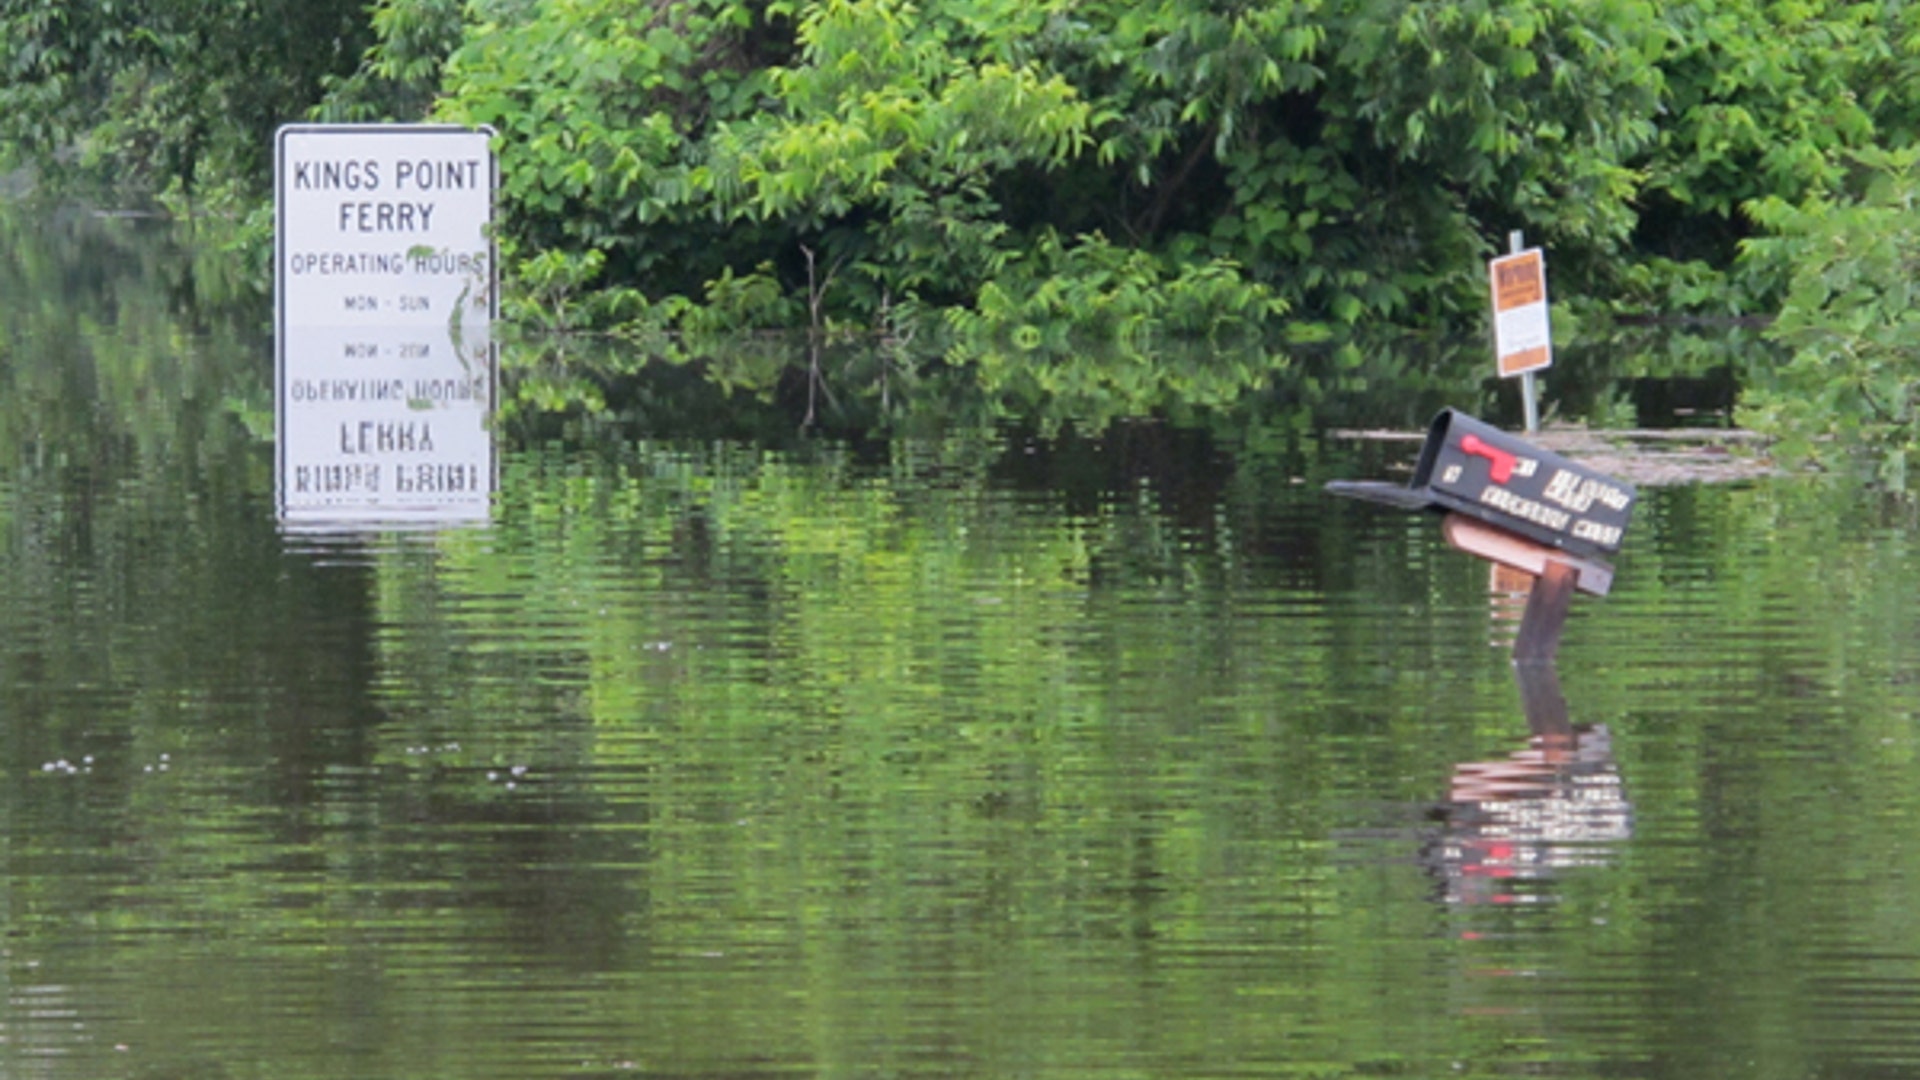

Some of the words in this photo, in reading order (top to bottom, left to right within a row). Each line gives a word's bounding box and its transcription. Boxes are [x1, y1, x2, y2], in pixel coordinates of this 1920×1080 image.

[294, 160, 380, 190] KINGS
[396, 160, 479, 190] POINT
[340, 203, 433, 232] FERRY
[291, 253, 404, 275] OPERATING
[344, 297, 378, 311] MON
[400, 297, 430, 311] SUN
